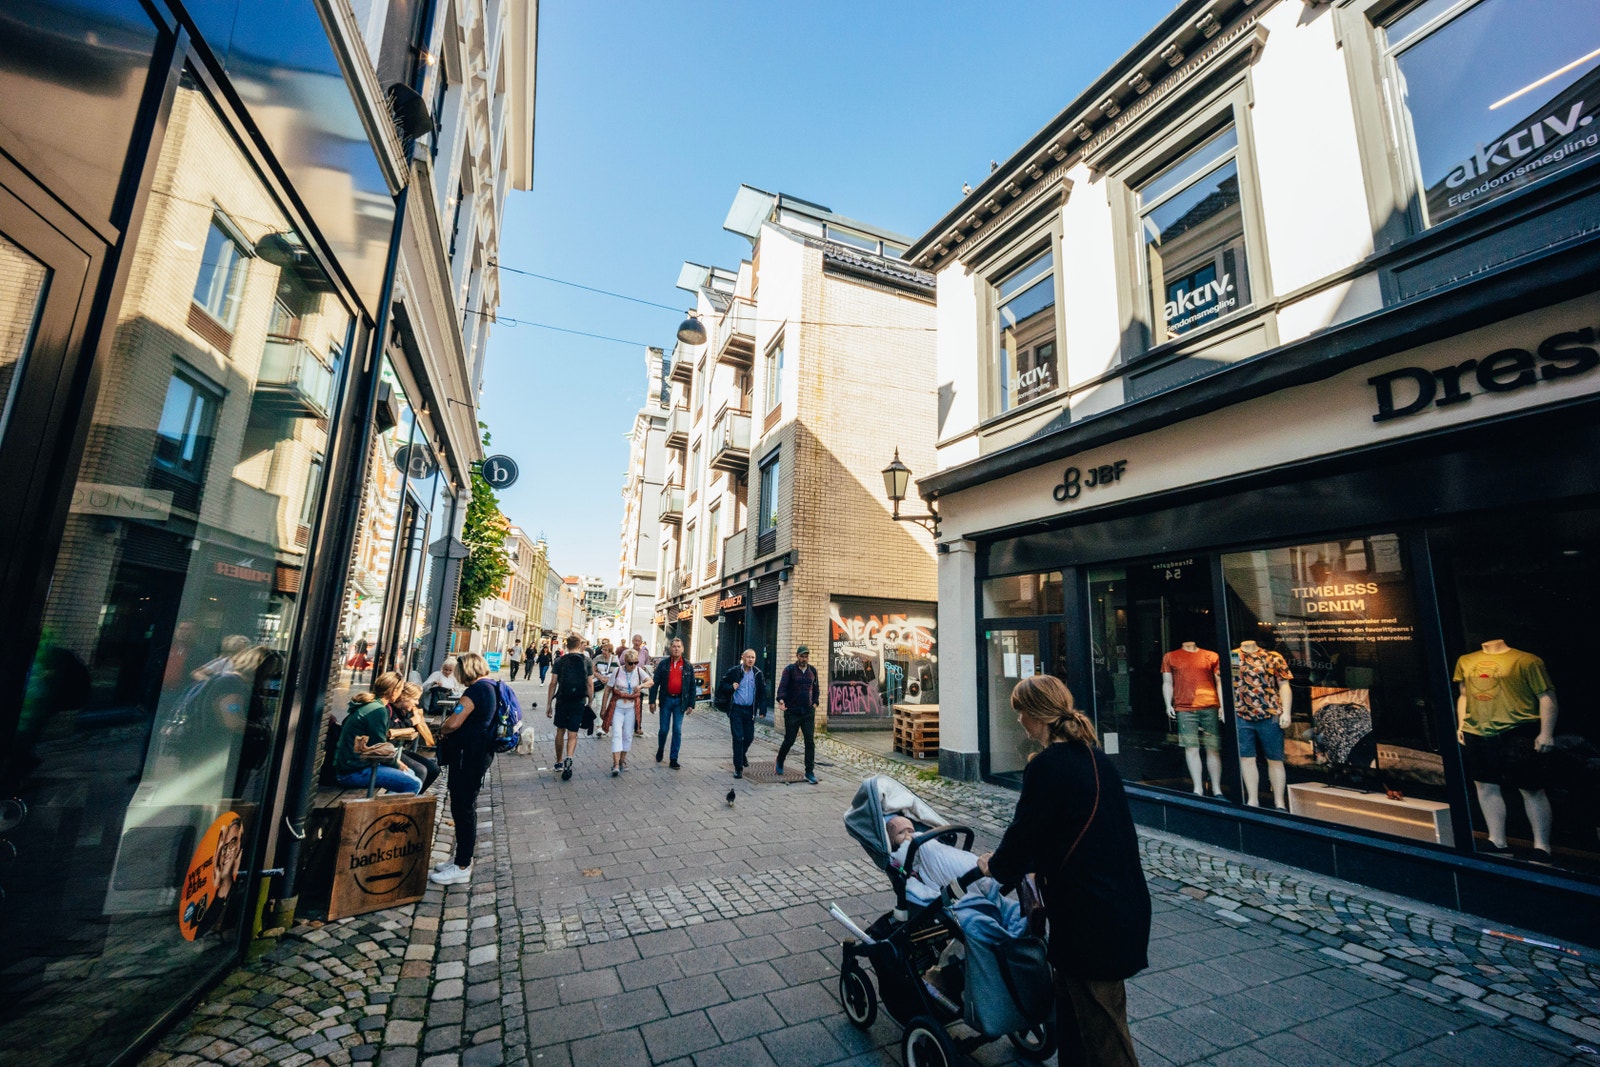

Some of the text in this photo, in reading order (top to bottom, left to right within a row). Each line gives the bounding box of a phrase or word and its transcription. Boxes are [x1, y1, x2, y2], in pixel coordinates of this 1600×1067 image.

[1448, 132, 1598, 208] Eiendomsmegling
[491, 460, 509, 482] b
[1084, 459, 1128, 488] JBF
[1291, 582, 1379, 599] TIMELESS
[1306, 599, 1366, 613] DENIM
[1365, 626, 1410, 634] favorittjeans
[349, 841, 424, 869] backstube
